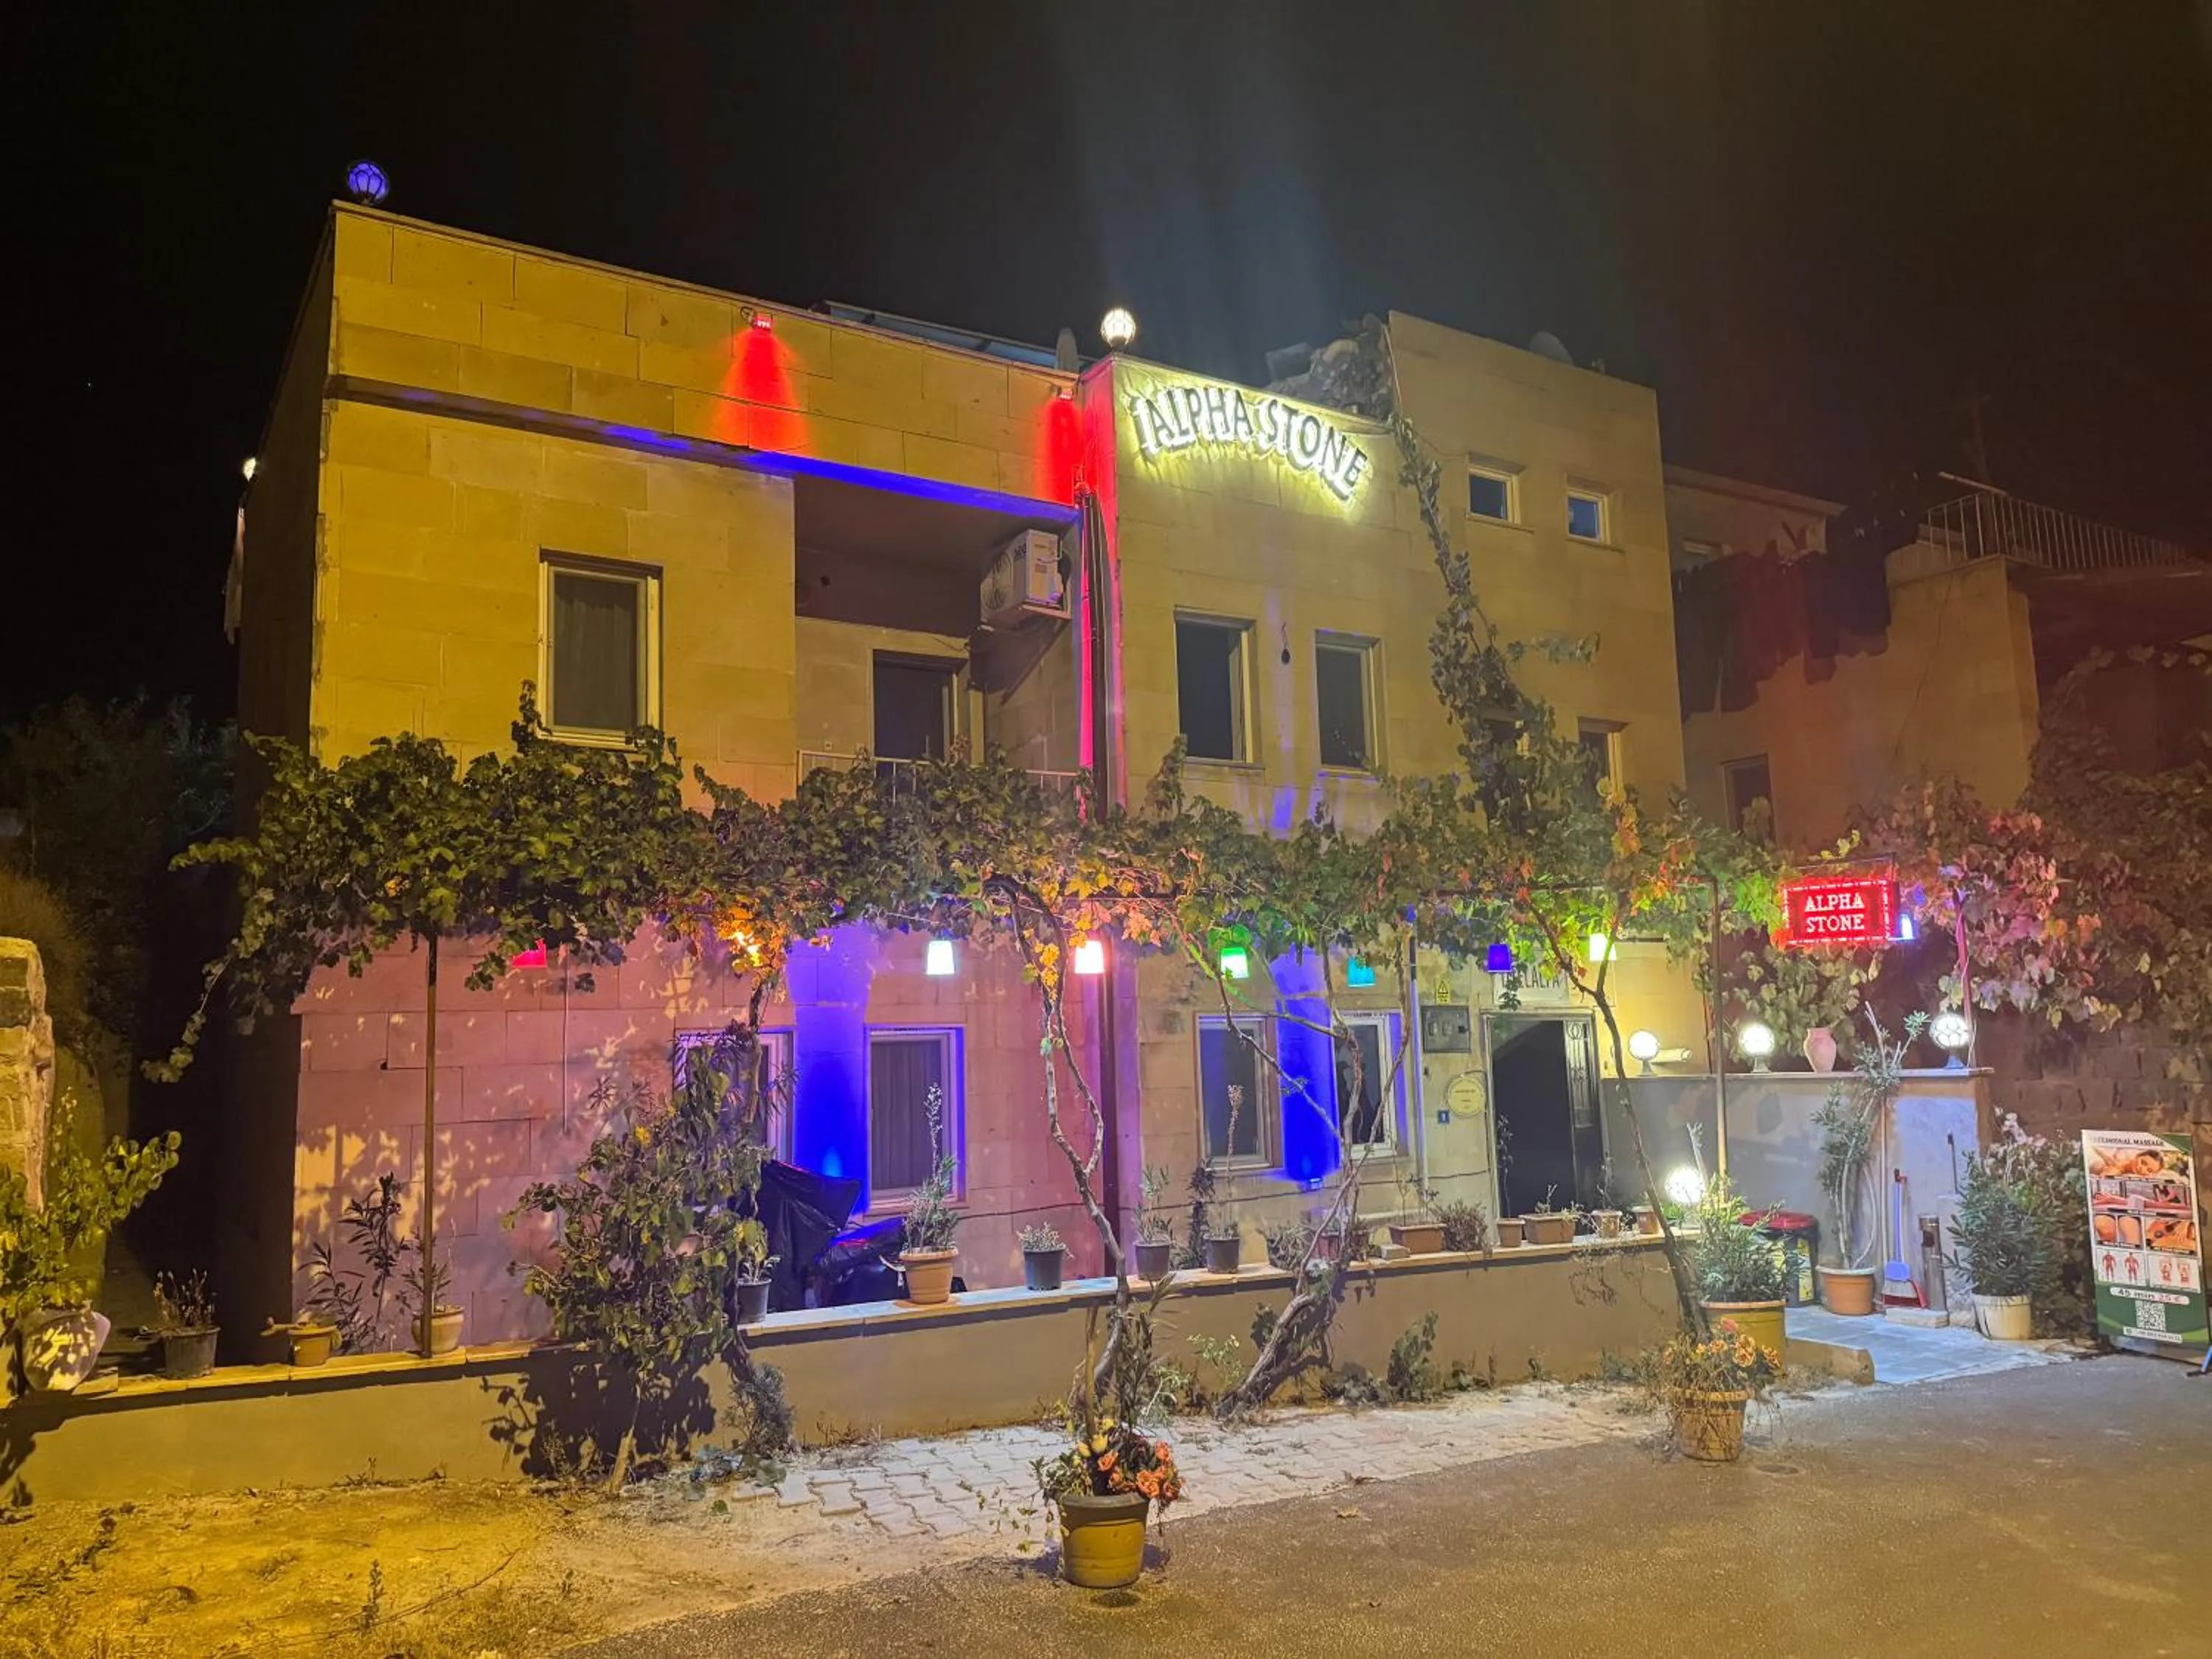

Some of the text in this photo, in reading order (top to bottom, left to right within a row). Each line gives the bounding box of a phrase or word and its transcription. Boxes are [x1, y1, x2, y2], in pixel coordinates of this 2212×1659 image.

[1138, 386, 1368, 490] ALPHA STONE
[1805, 893, 1864, 912] ALPHA
[1806, 914, 1865, 932] STONE
